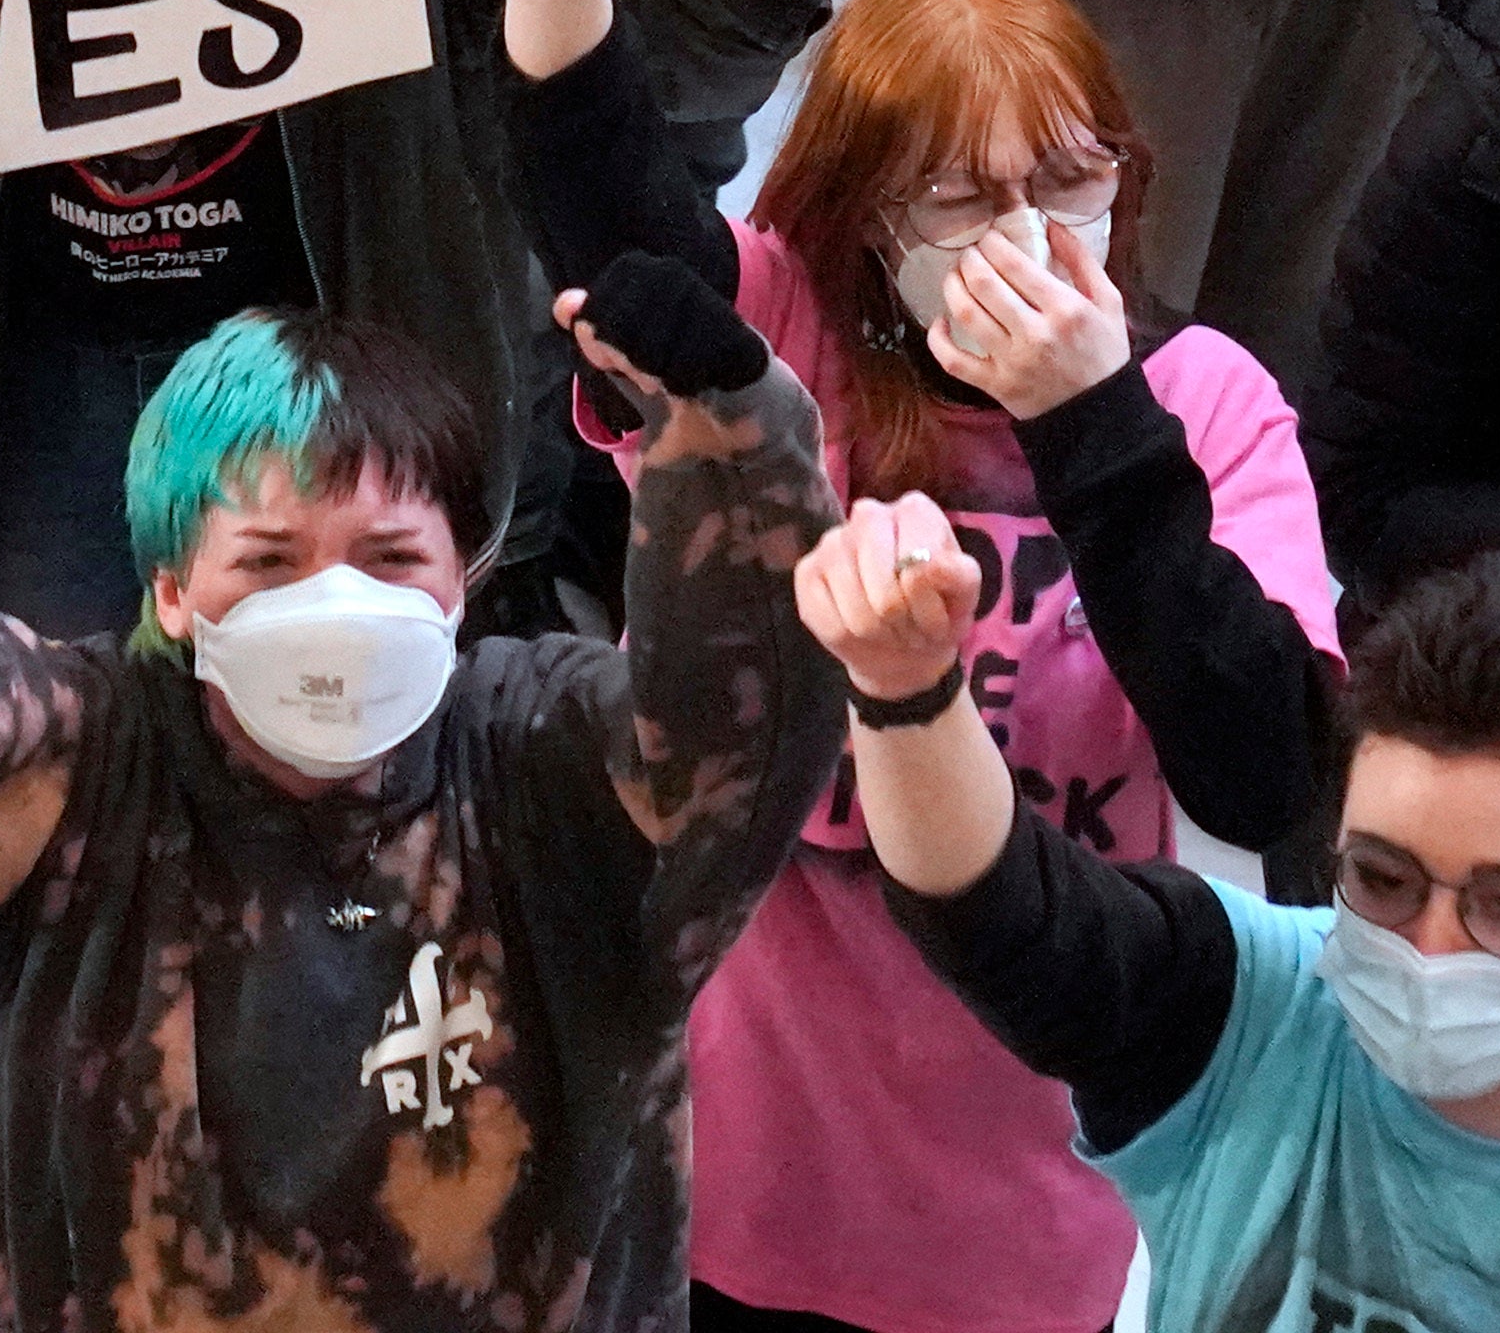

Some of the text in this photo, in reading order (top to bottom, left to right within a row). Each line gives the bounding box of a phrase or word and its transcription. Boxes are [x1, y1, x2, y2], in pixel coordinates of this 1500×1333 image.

[51, 192, 243, 237] HIMIKO TOGA
[106, 233, 182, 254] VILLAIN
[299, 674, 345, 698] 3M
